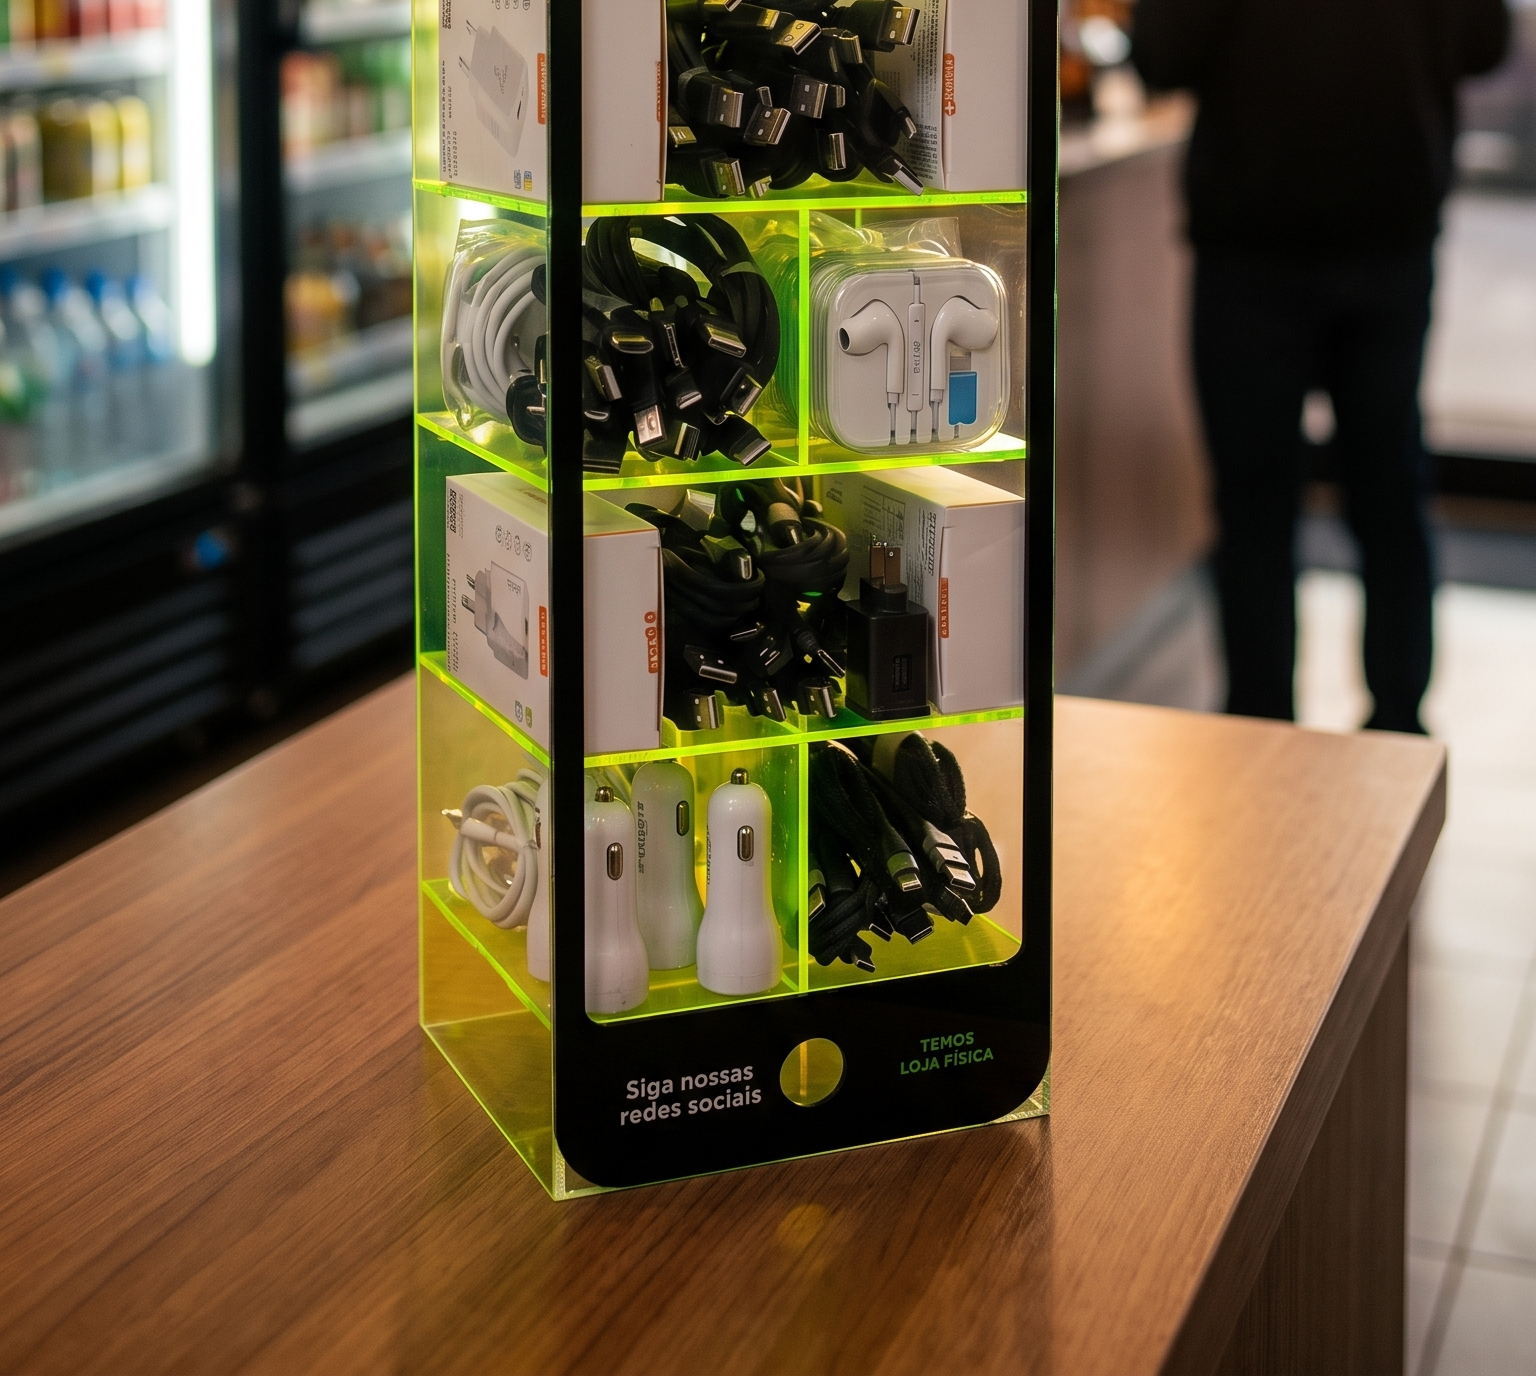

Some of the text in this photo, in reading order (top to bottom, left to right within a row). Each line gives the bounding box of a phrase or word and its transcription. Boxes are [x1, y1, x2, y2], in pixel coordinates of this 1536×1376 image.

[920, 1032, 974, 1053] TEMOS
[900, 1047, 994, 1075] LOJA FÍSICA
[626, 1065, 754, 1101] Siga nossas
[620, 1085, 762, 1126] redes sociais
